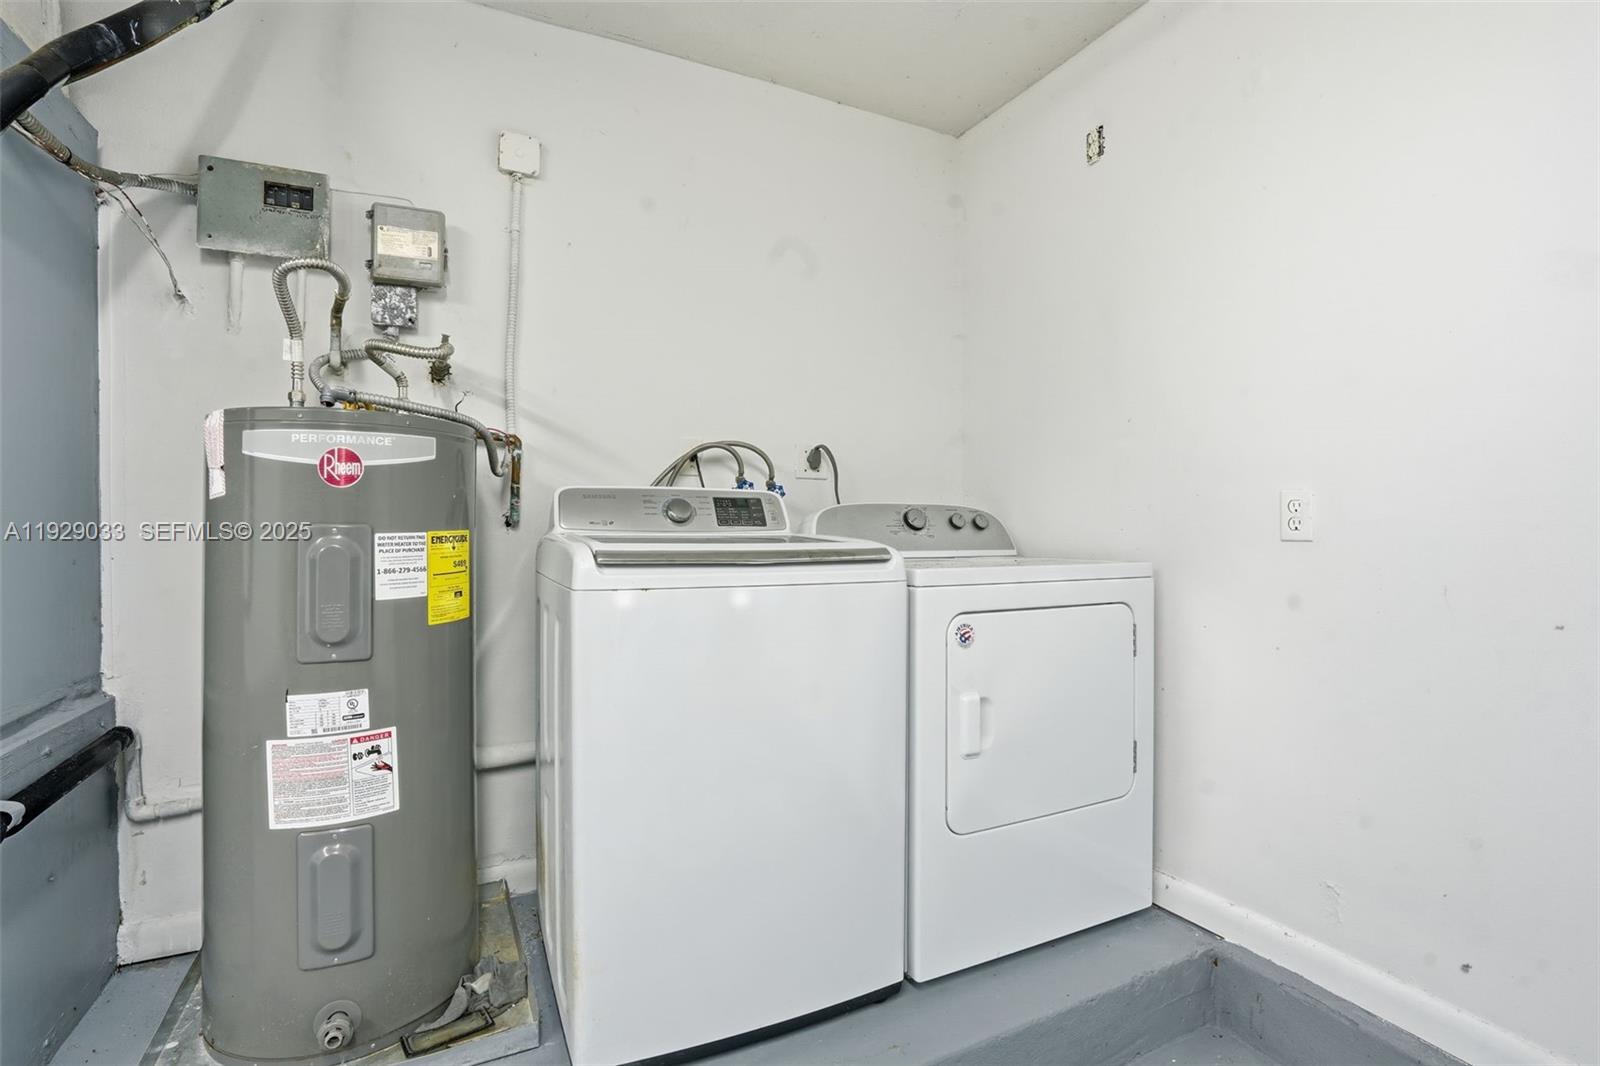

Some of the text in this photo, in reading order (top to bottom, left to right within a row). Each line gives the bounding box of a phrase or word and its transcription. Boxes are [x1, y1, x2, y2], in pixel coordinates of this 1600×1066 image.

[291, 433, 393, 446] PERFORMANCE
[323, 448, 361, 480] Rheem
[377, 566, 427, 575] 1-866-279-4566
[360, 732, 390, 742] DANGER
